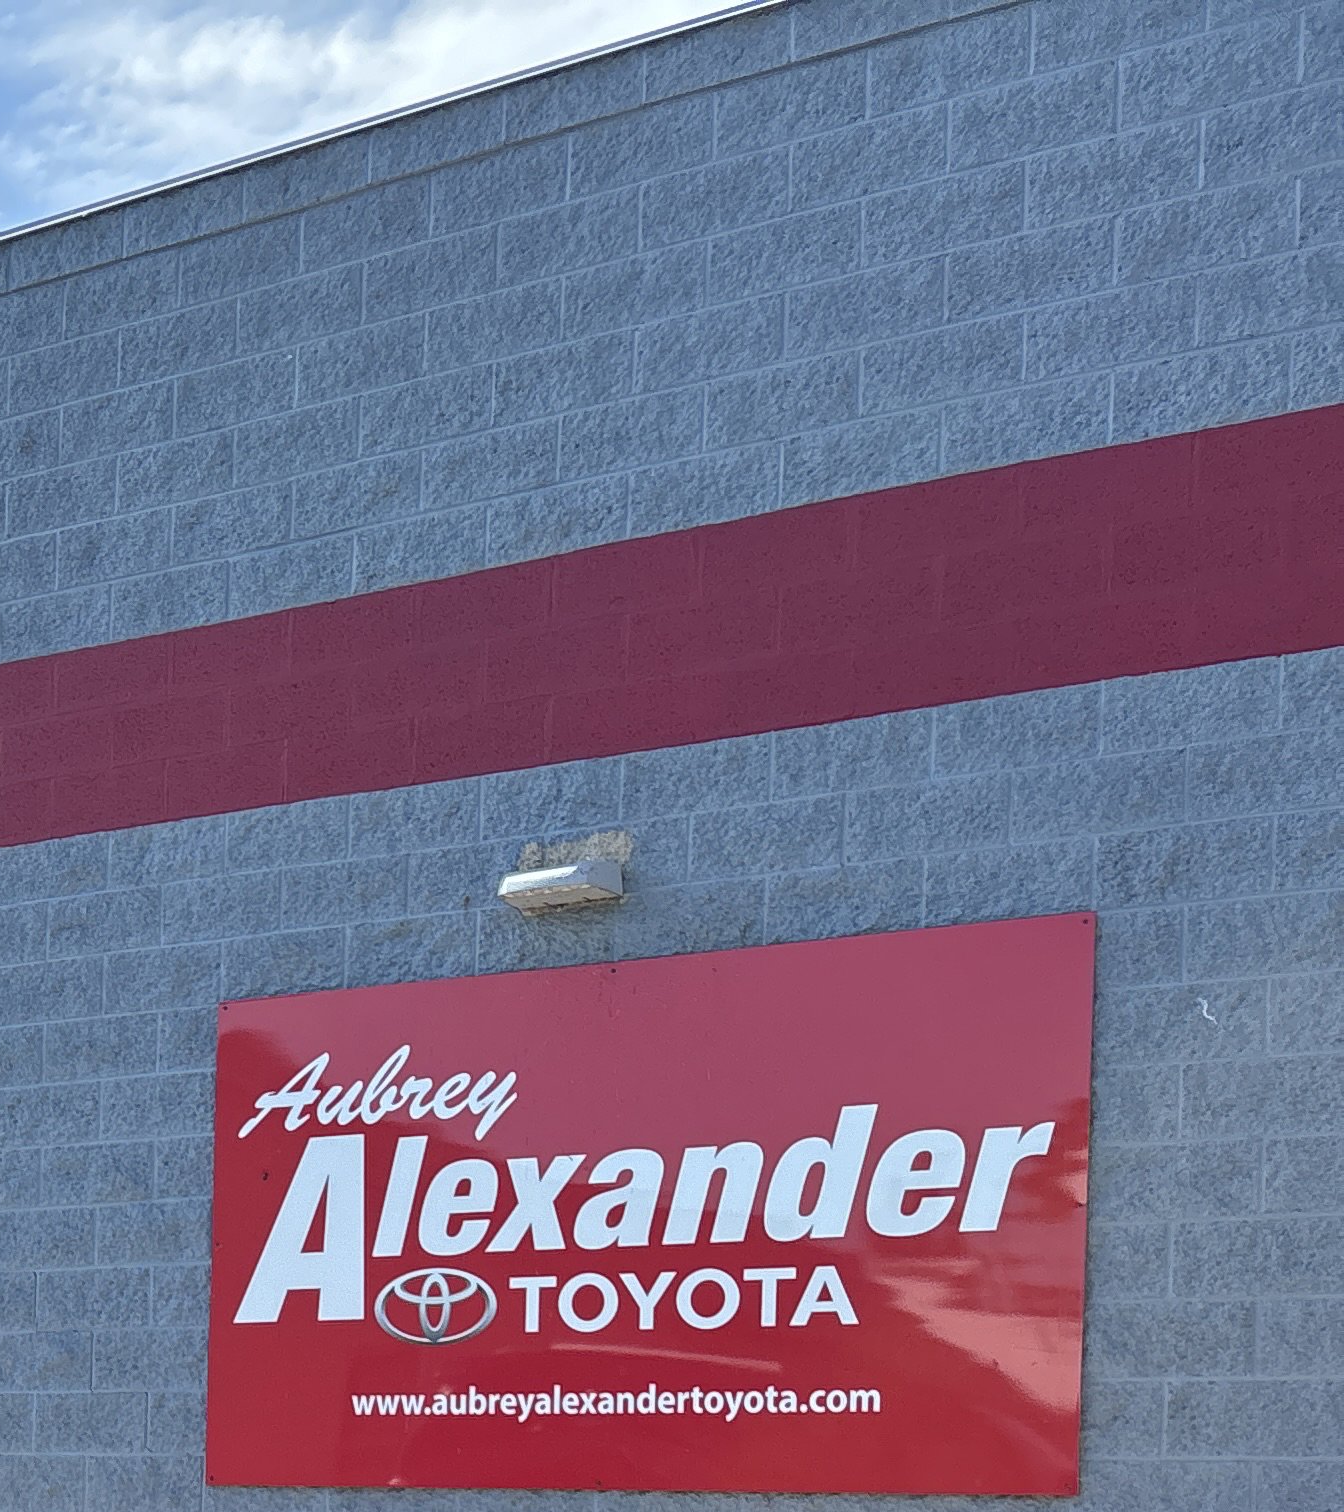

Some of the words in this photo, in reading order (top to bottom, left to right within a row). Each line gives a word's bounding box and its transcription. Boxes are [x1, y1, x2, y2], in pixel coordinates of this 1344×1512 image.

[238, 1044, 518, 1140] Aubrey
[234, 1104, 1056, 1324] Alexander
[509, 1266, 860, 1333] TOYOTA
[351, 1383, 881, 1423] www.aubreyalexandertoyota.com
